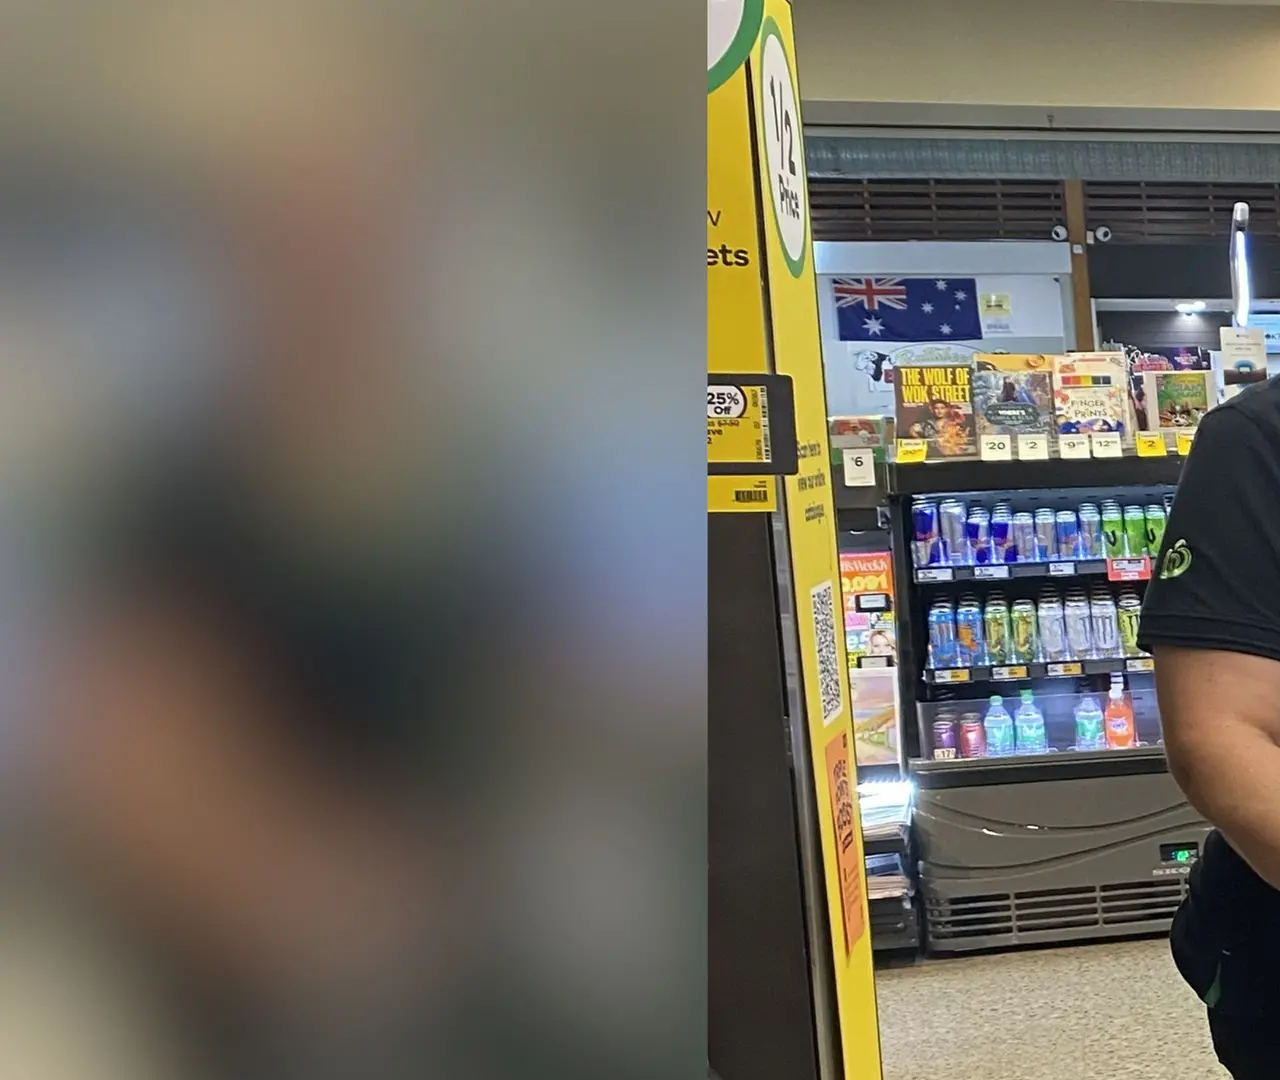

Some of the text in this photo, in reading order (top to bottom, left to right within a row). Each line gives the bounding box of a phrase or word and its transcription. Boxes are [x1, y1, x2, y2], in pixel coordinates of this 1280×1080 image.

[900, 367, 969, 385] THE WOLF OF
[707, 392, 740, 405] 25%
[902, 385, 970, 403] WOK STREET
[1071, 400, 1106, 409] FINGER
